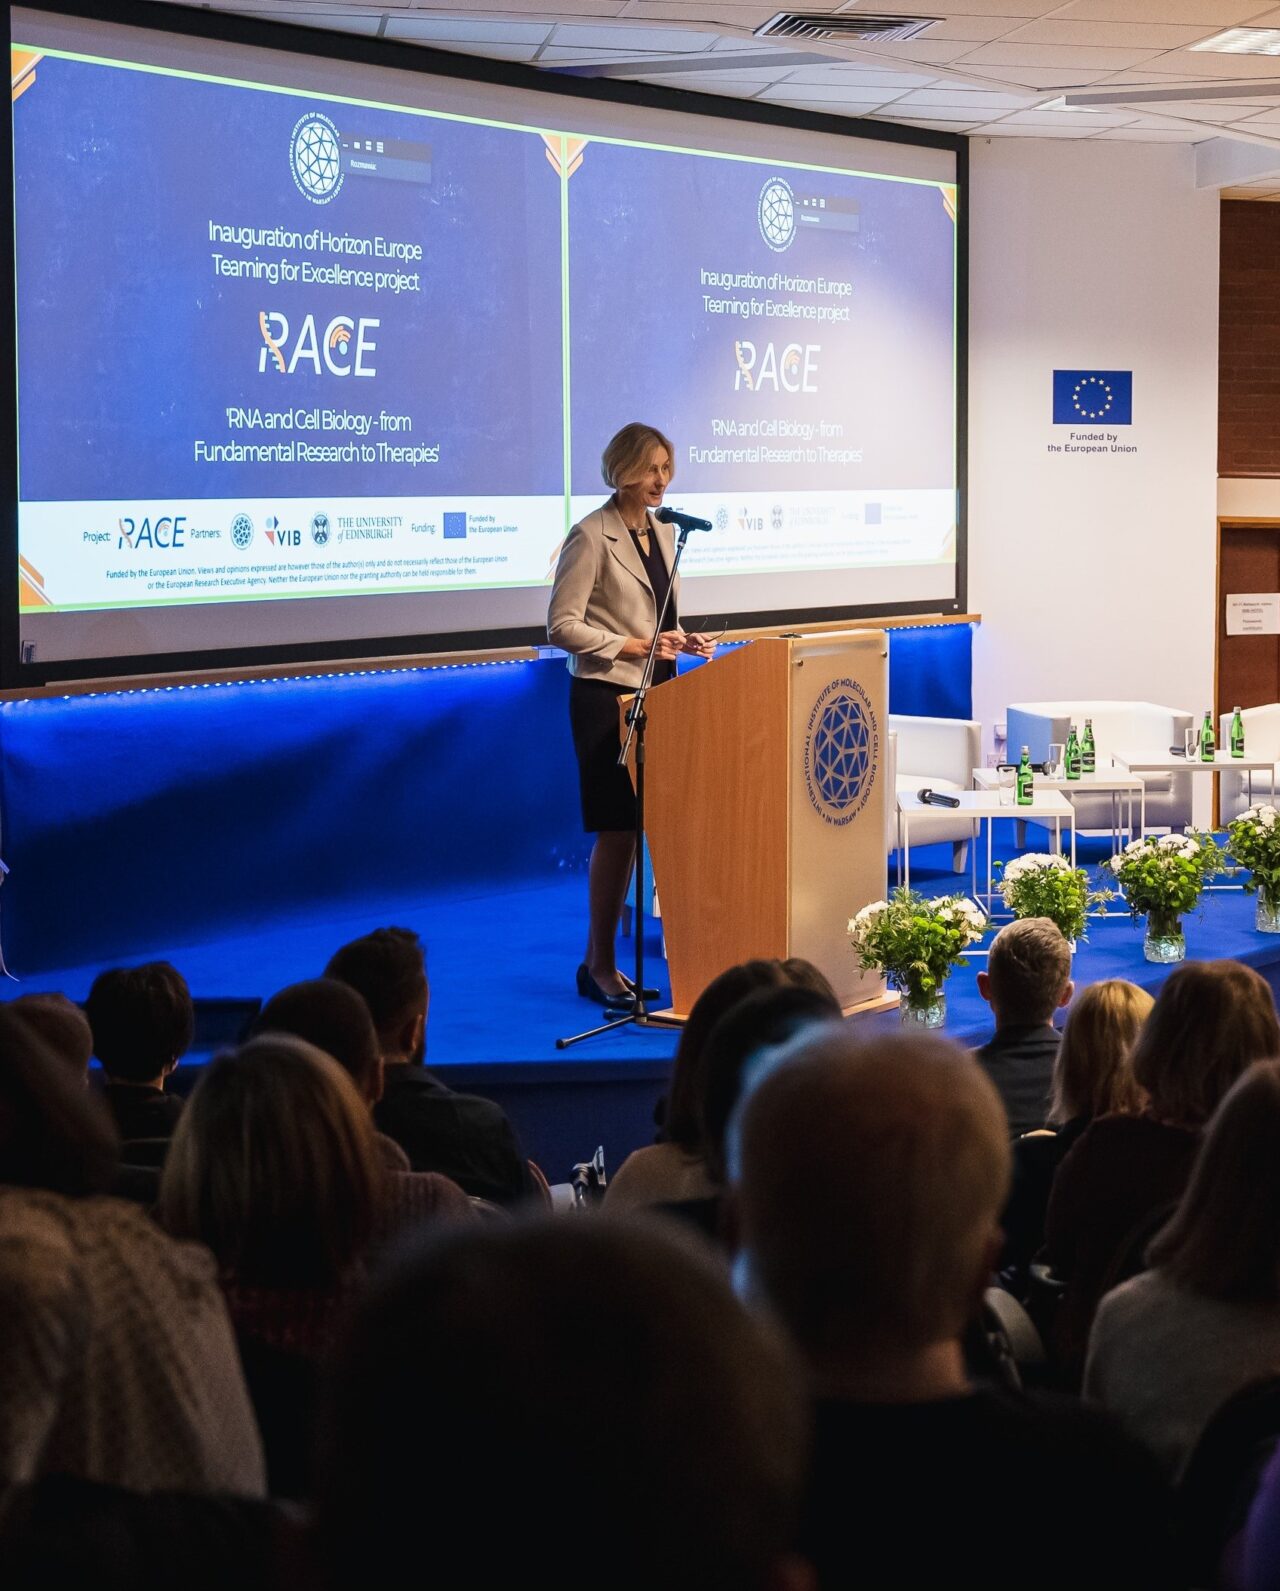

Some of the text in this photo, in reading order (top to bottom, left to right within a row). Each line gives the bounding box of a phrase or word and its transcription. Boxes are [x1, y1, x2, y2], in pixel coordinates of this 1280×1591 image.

[209, 219, 423, 264] Inauguration of Horizon Europe
[211, 253, 420, 295] Teaming for Excellence project
[700, 268, 853, 299] Inauguration of Horizon Europe
[702, 295, 850, 324] Teaming for Excellence project
[258, 311, 380, 377] RACE
[734, 340, 821, 393] RACE
[264, 408, 293, 429] and
[295, 409, 320, 430] Cell
[322, 409, 373, 435] Biology
[379, 410, 412, 431] from
[738, 420, 758, 437] and
[759, 420, 778, 437] Cell
[779, 420, 815, 441] Biology
[819, 420, 843, 437] from
[1070, 432, 1118, 442] Funded by
[194, 440, 295, 462] Fundamental
[296, 441, 360, 463] Research
[361, 444, 376, 463] to
[689, 446, 759, 464] Fundamental
[760, 446, 806, 463] Research
[806, 448, 817, 463] to
[1047, 444, 1138, 454] the European Union
[337, 516, 403, 528] THE UNIVERSITY
[469, 515, 496, 524] Funded by
[745, 517, 763, 531] VIB
[83, 531, 111, 545] Project:
[118, 516, 187, 549] RACE
[190, 528, 222, 539] Partners:
[277, 530, 301, 546] VIB
[337, 528, 393, 544] of EDINBURGH
[468, 525, 477, 533] the
[477, 525, 502, 535] European
[106, 570, 129, 579] Funded
[129, 570, 137, 579] by
[138, 569, 148, 577] the
[149, 568, 176, 578] European
[197, 567, 214, 575] Views
[215, 566, 226, 574] and
[226, 565, 249, 574] opinions
[156, 581, 165, 589] the
[166, 580, 193, 590] European
[194, 578, 220, 587] Research
[220, 578, 246, 586] Executive
[831, 679, 840, 690] OF
[840, 678, 872, 709] MOLECULAR
[809, 684, 831, 731] INSTITUTE
[869, 710, 878, 732] AND
[804, 736, 823, 817] INTERNATIONAL
[860, 764, 878, 809] BIOLOGY
[825, 808, 857, 827] IN WARSAW
